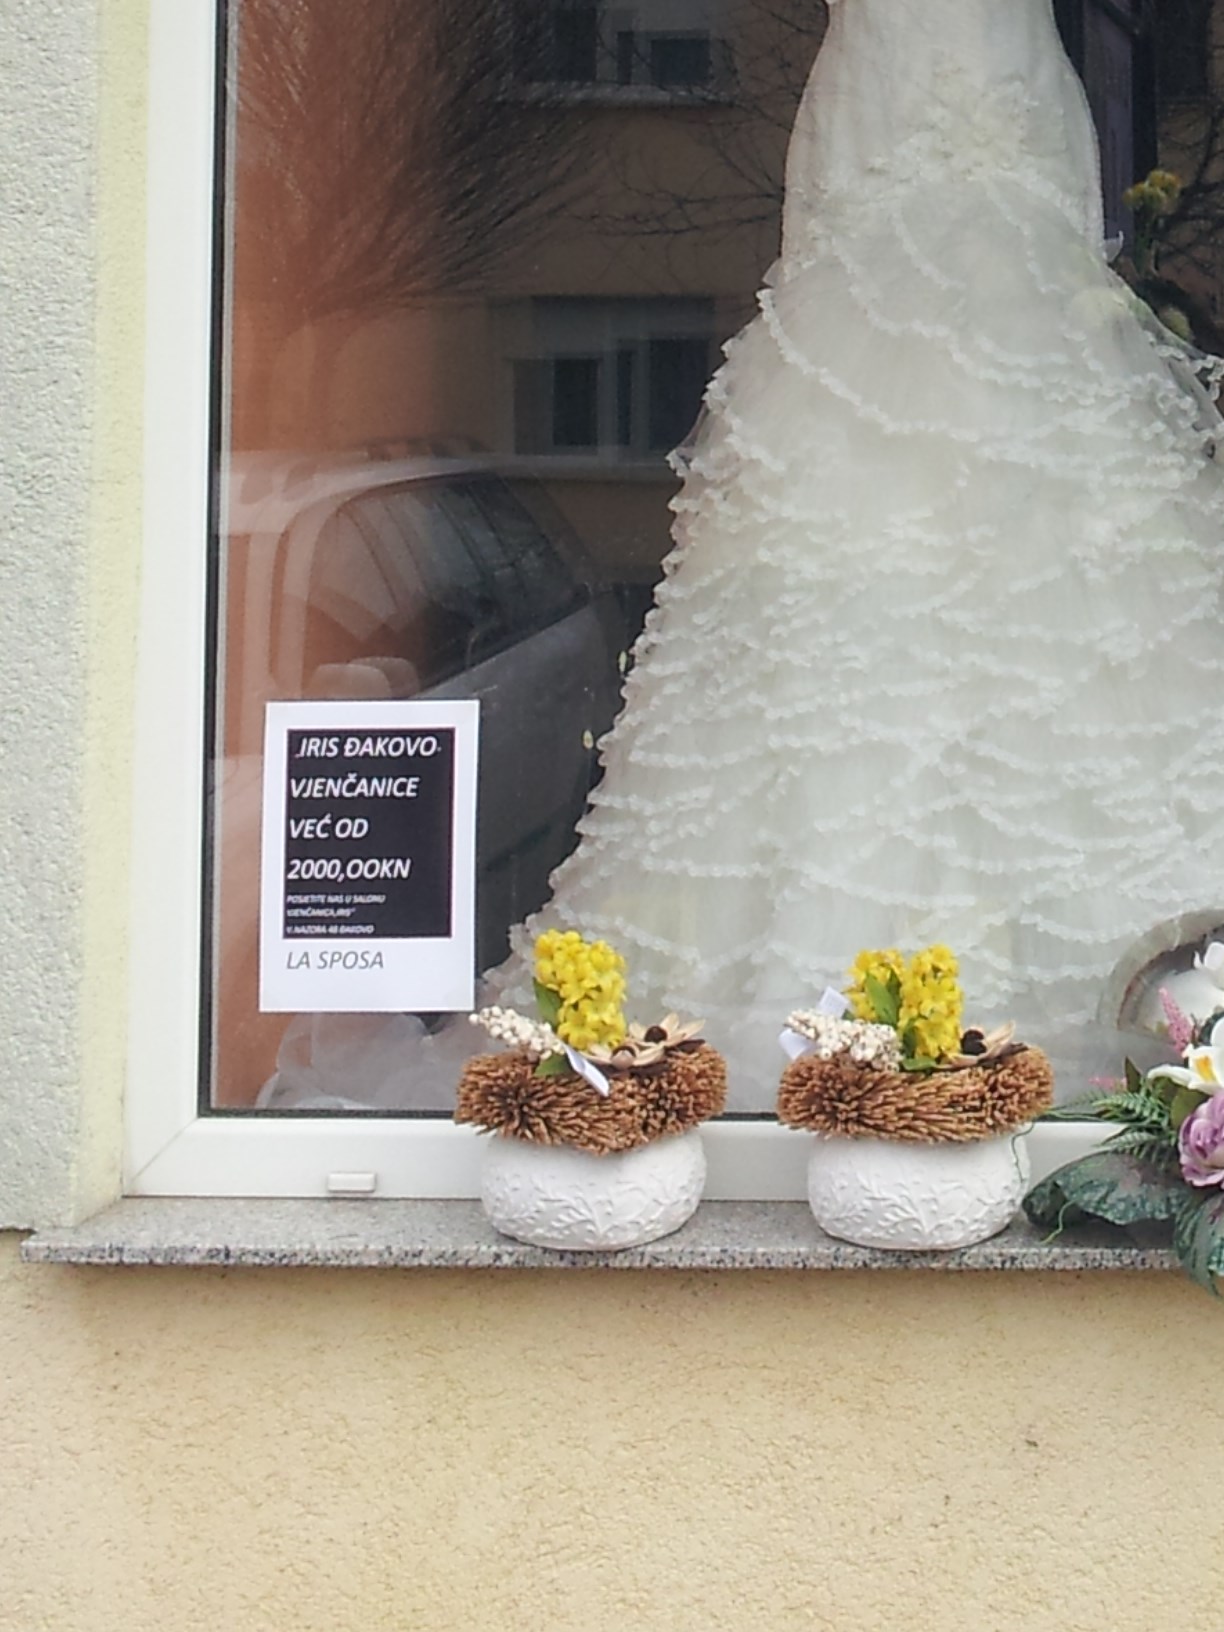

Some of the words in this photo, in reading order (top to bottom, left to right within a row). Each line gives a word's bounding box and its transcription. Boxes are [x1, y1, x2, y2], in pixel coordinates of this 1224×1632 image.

[290, 772, 420, 798] VJENČANICE
[289, 813, 332, 838] VEĆ
[334, 818, 368, 838] OD
[286, 951, 310, 970] LA
[316, 950, 384, 970] SPOSA
